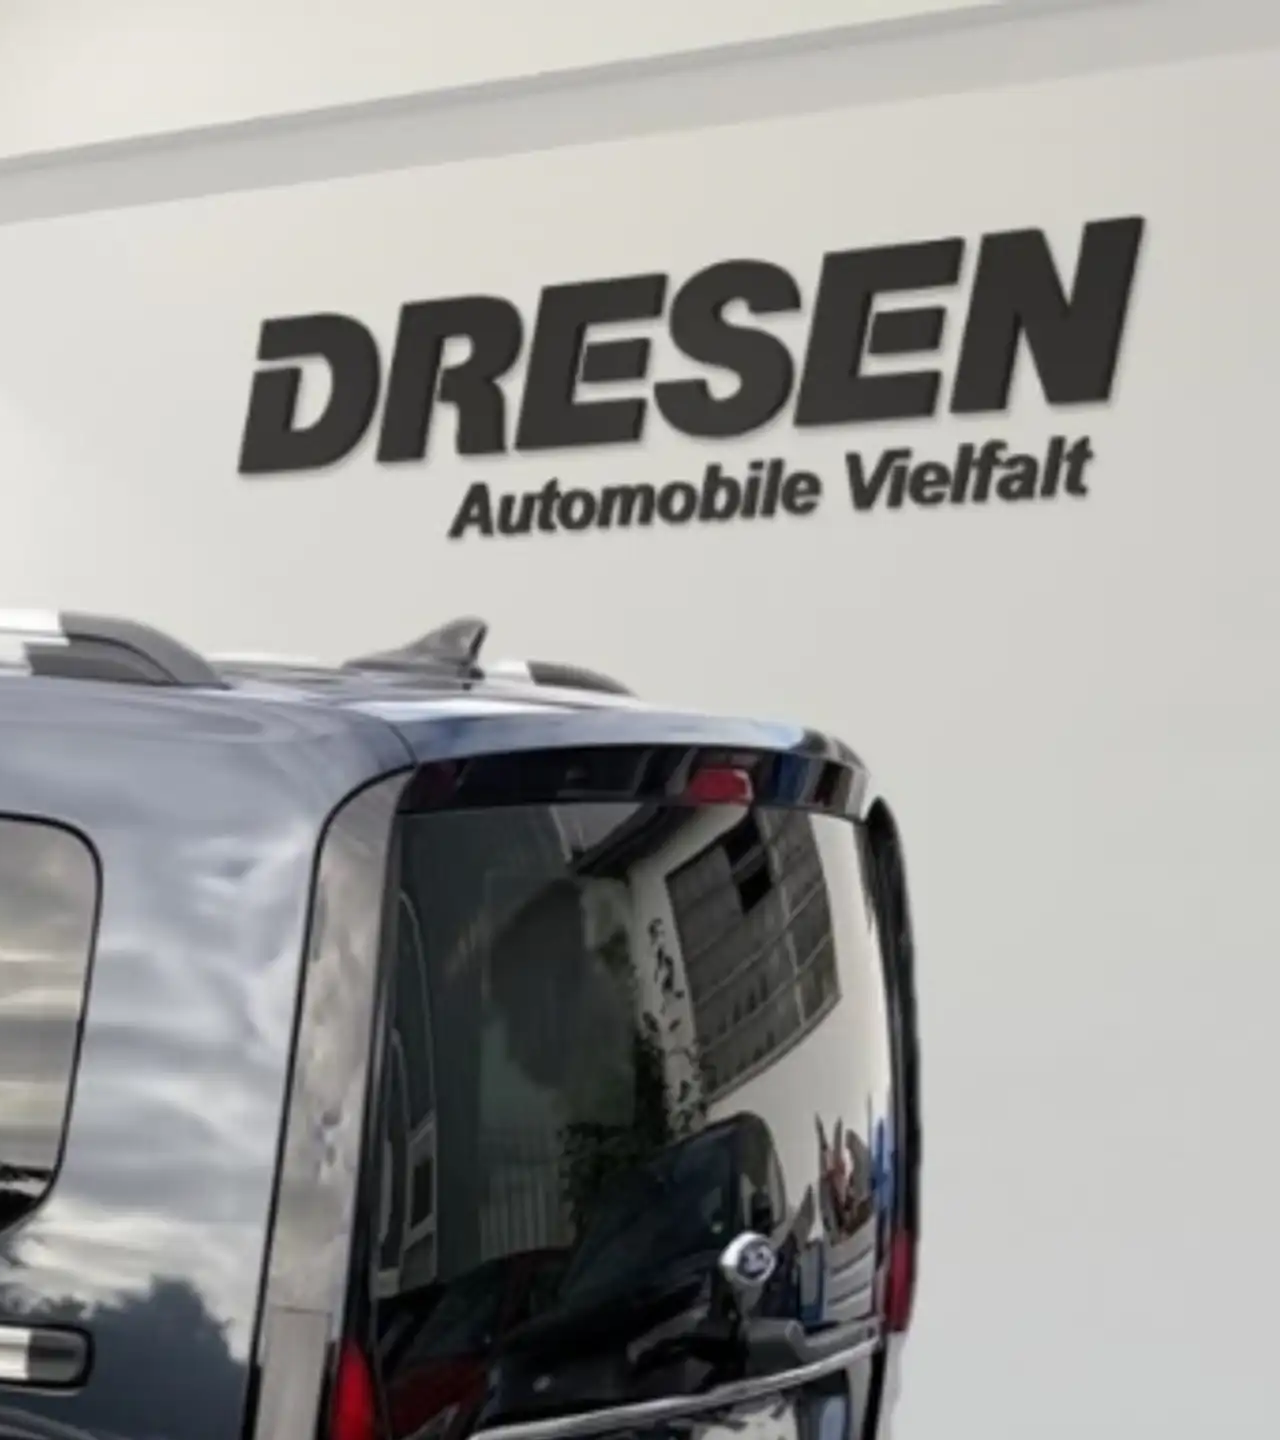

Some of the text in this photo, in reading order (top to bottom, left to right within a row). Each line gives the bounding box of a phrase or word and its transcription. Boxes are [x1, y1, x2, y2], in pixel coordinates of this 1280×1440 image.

[237, 216, 1145, 475] DRESEN
[448, 436, 1094, 539] Automobile Vielfalt
